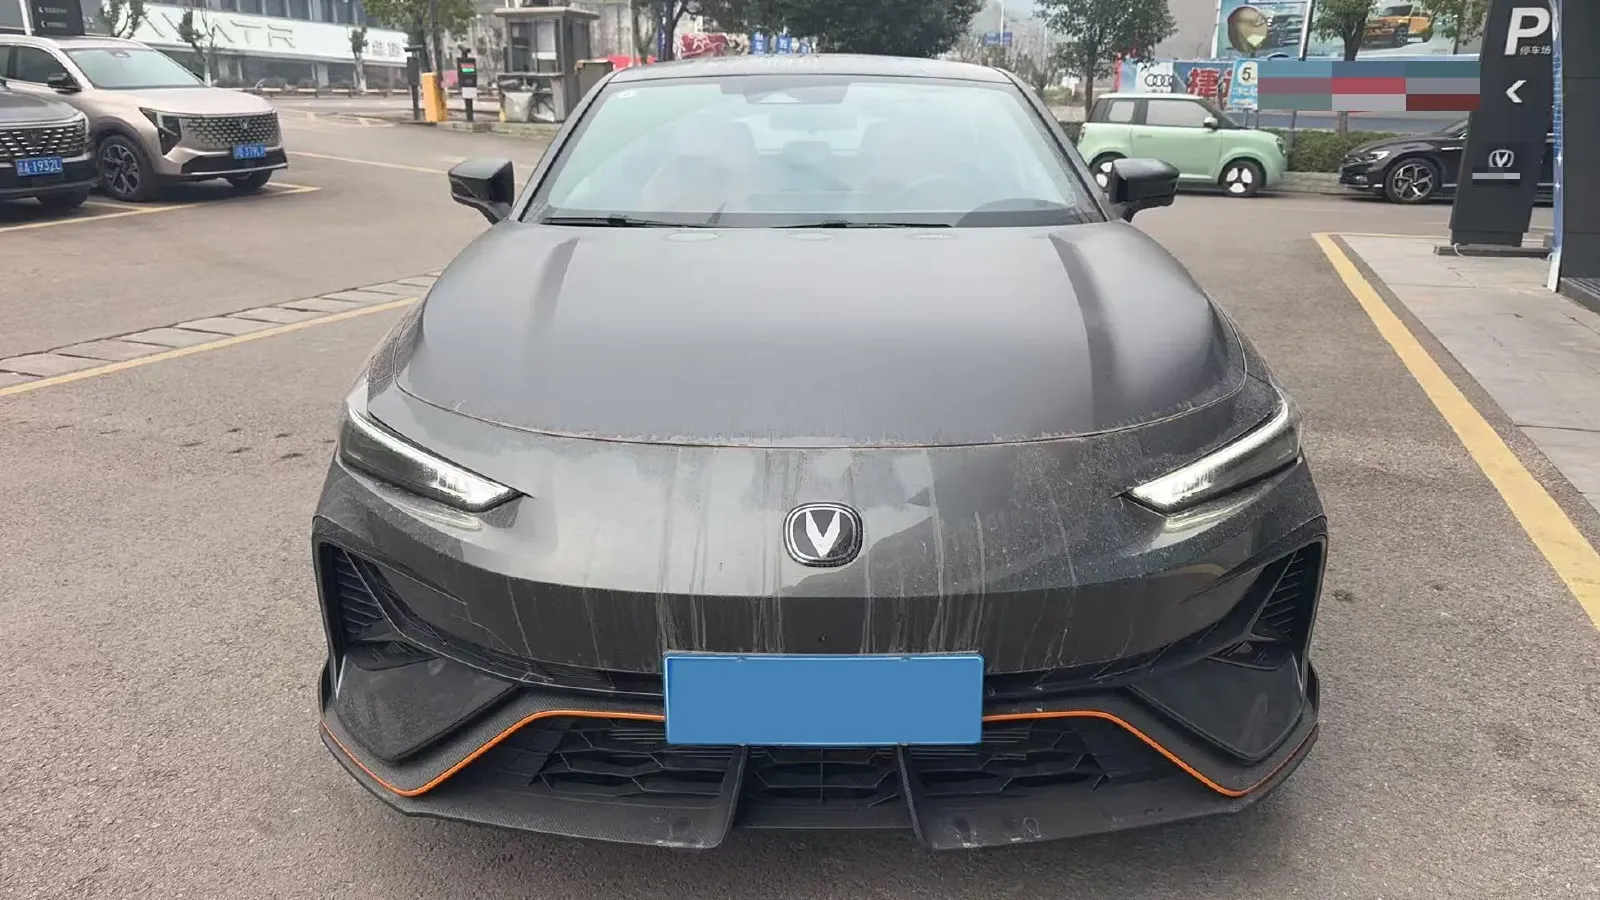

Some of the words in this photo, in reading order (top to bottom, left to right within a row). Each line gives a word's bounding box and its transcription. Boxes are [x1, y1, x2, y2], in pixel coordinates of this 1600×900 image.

[1504, 7, 1550, 55] P
[1520, 45, 1552, 56] 停车场
[1242, 66, 1253, 82] 5
